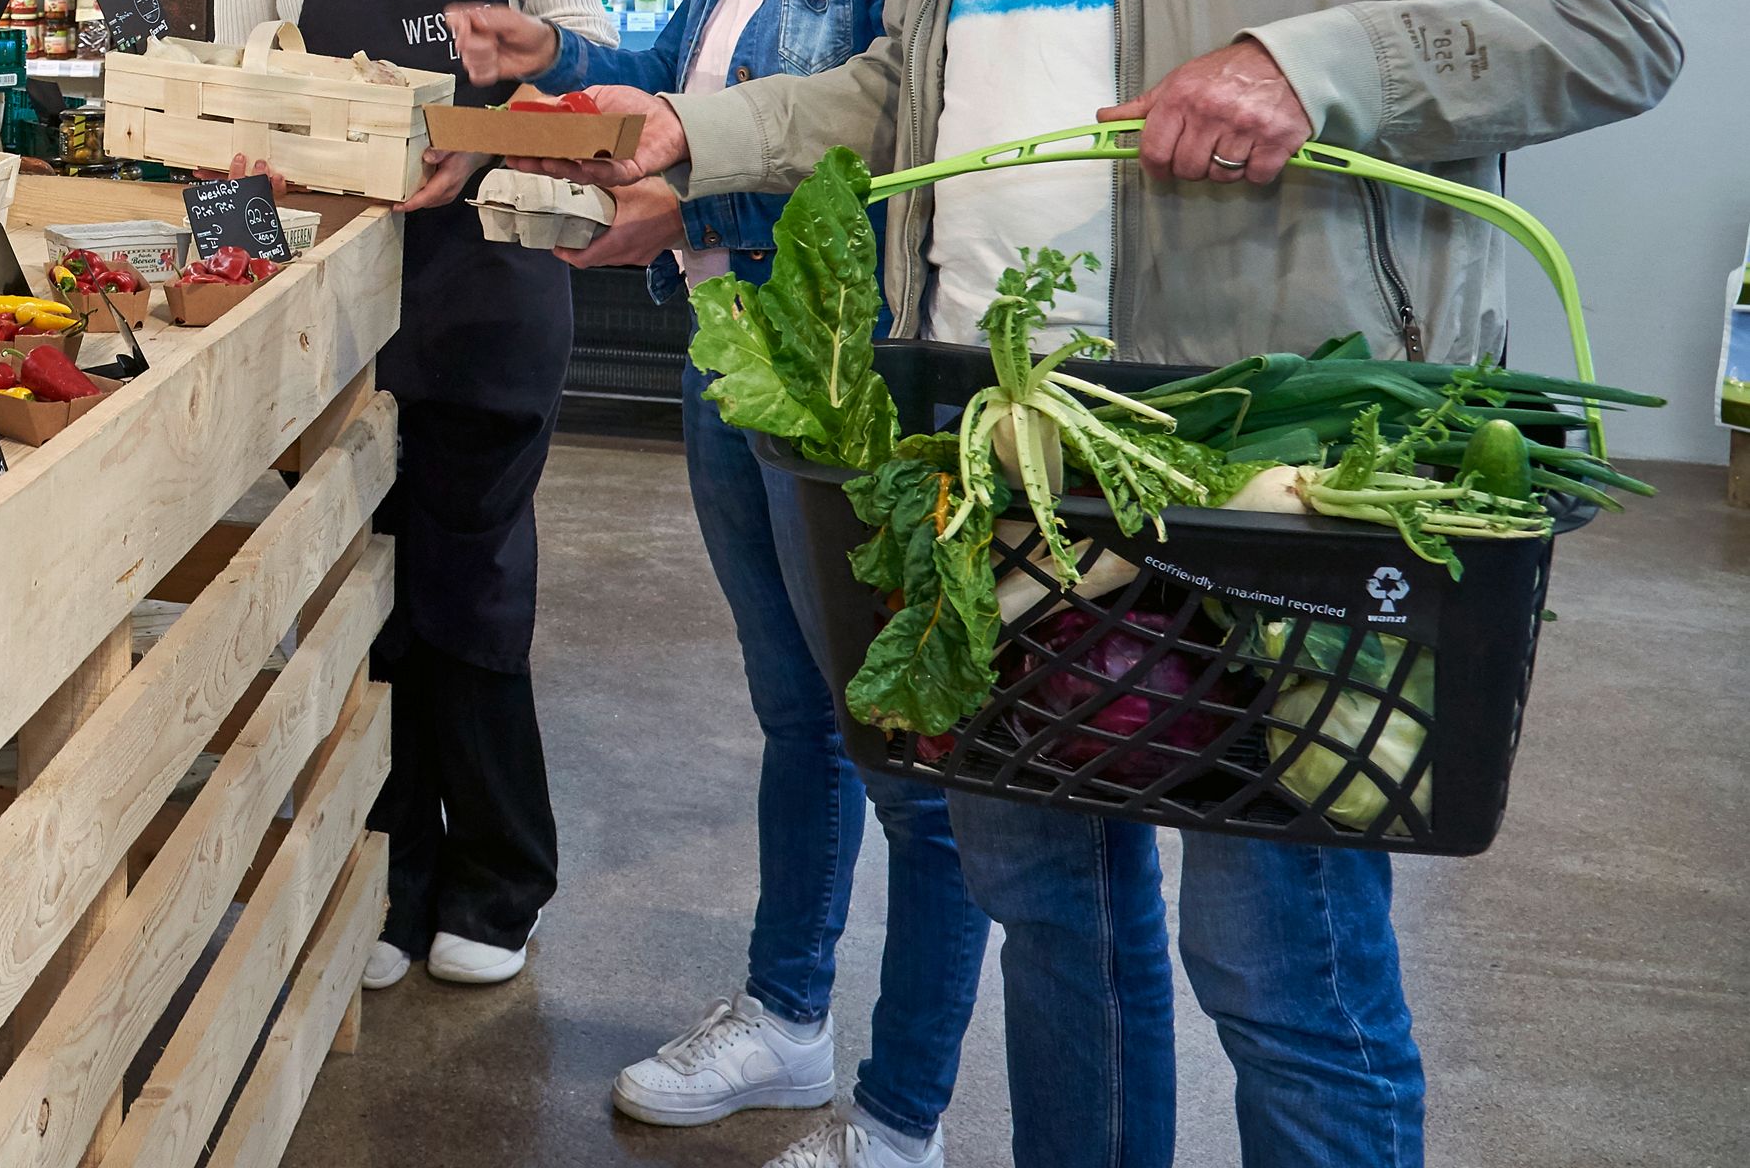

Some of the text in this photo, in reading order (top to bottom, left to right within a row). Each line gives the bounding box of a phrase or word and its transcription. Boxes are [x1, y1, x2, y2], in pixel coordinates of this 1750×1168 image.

[132, 257, 156, 265] Beeren
[1145, 554, 1214, 591] ecofriendly
[1226, 585, 1284, 606] maximal
[1287, 597, 1346, 618] recycled
[1367, 613, 1407, 623] wanzl
